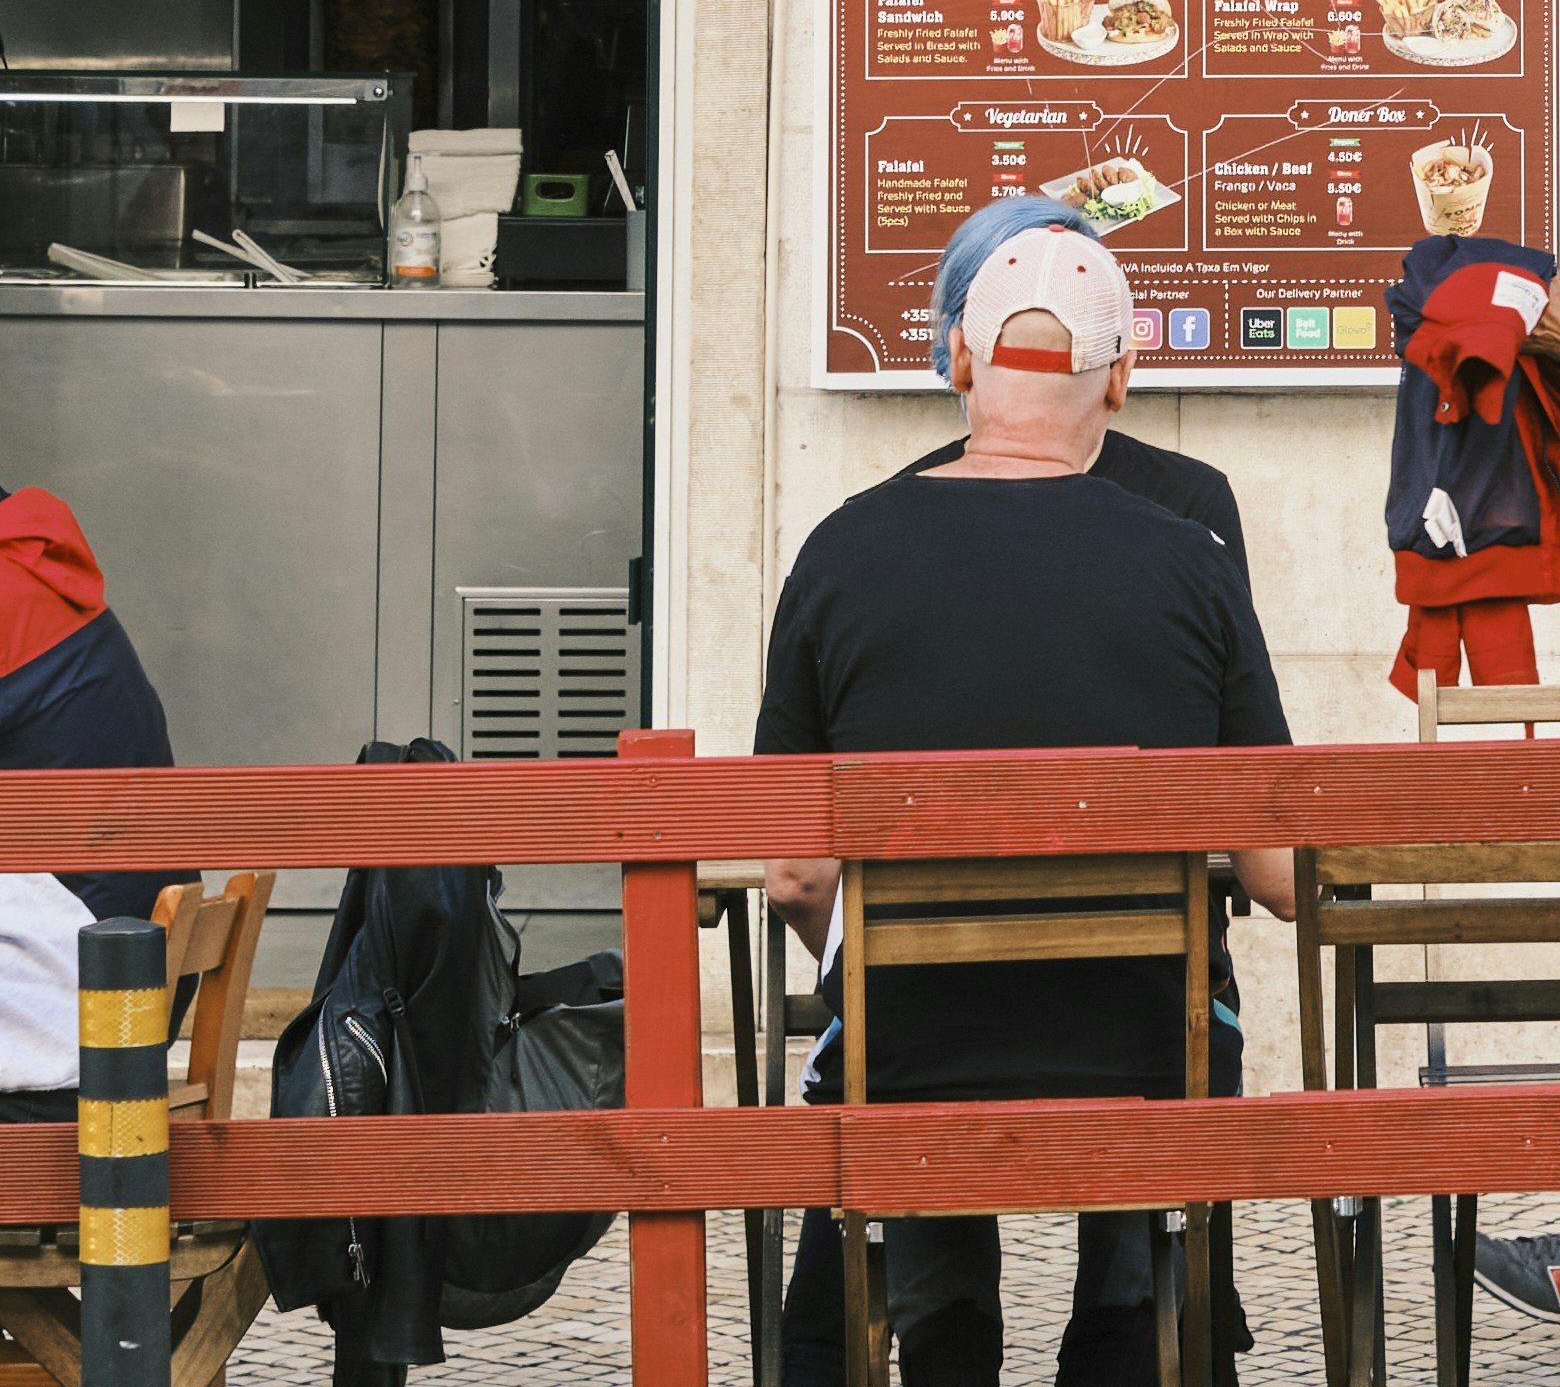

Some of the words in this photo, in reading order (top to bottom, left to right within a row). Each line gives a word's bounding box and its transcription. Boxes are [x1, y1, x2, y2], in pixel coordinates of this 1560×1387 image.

[1215, 0, 1262, 12] Falafel
[1262, 0, 1298, 13] Wrap
[878, 11, 943, 23] Sandwich
[985, 107, 1067, 128] Vegetarian
[1328, 106, 1374, 123] Doner
[1377, 107, 1406, 123] Box
[992, 155, 1026, 165] 3.50€
[878, 160, 924, 173] Falafel
[1213, 162, 1268, 175] Chicken
[1282, 162, 1312, 175] Beef
[992, 186, 1025, 197] 5.70€
[1215, 181, 1255, 193] Frango
[1267, 181, 1296, 191] Vaca
[1121, 263, 1139, 274] IVA
[1186, 263, 1193, 272] A
[1196, 263, 1220, 273] Taxa
[1223, 263, 1239, 272] Em
[1242, 263, 1269, 274] Vigor
[1150, 289, 1189, 299] Partner
[1257, 289, 1276, 298] Our
[1279, 288, 1320, 299] Delivery
[1323, 288, 1362, 298] Partner
[1248, 318, 1275, 328] Uber
[1296, 318, 1316, 329] Bolt
[1248, 329, 1275, 338] Eats
[1296, 328, 1321, 338] Food
